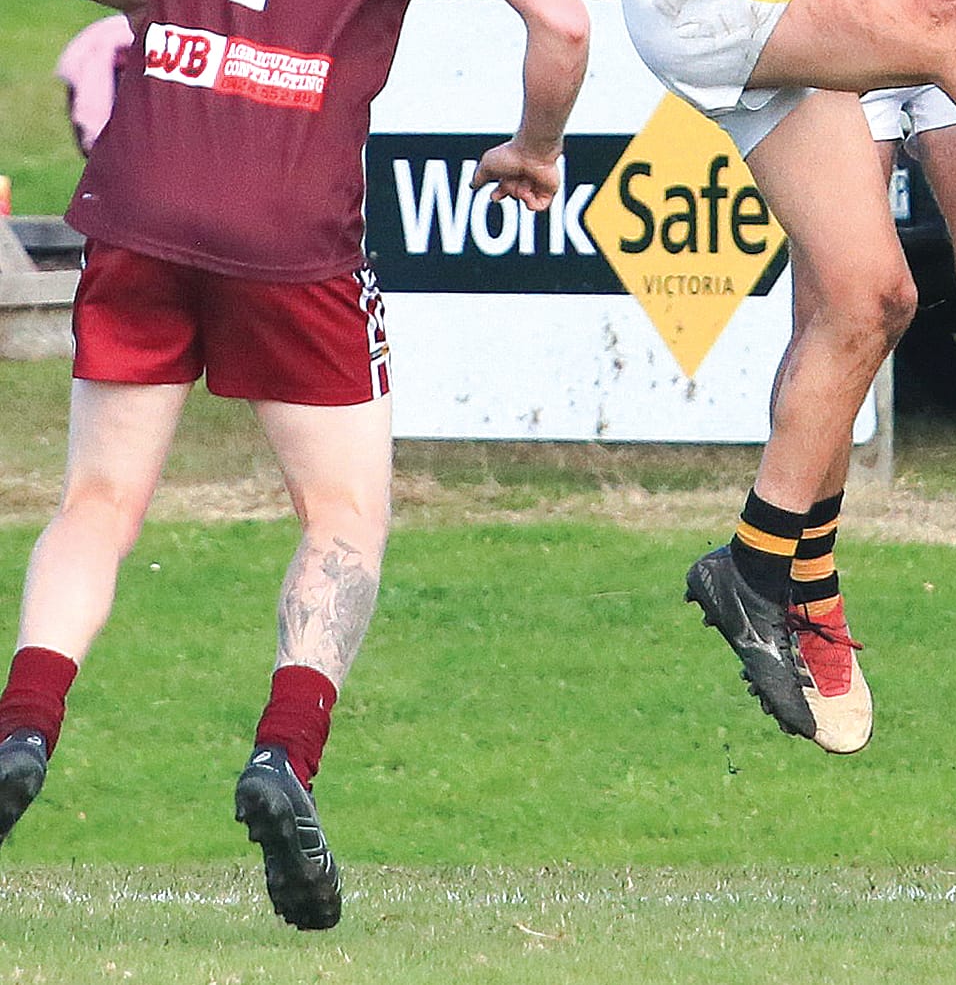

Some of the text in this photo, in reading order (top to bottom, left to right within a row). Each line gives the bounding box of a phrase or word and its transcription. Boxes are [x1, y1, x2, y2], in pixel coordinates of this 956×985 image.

[223, 60, 325, 94] CONTRACTING
[618, 154, 771, 256] Safe
[643, 274, 735, 297] VICTORIA
